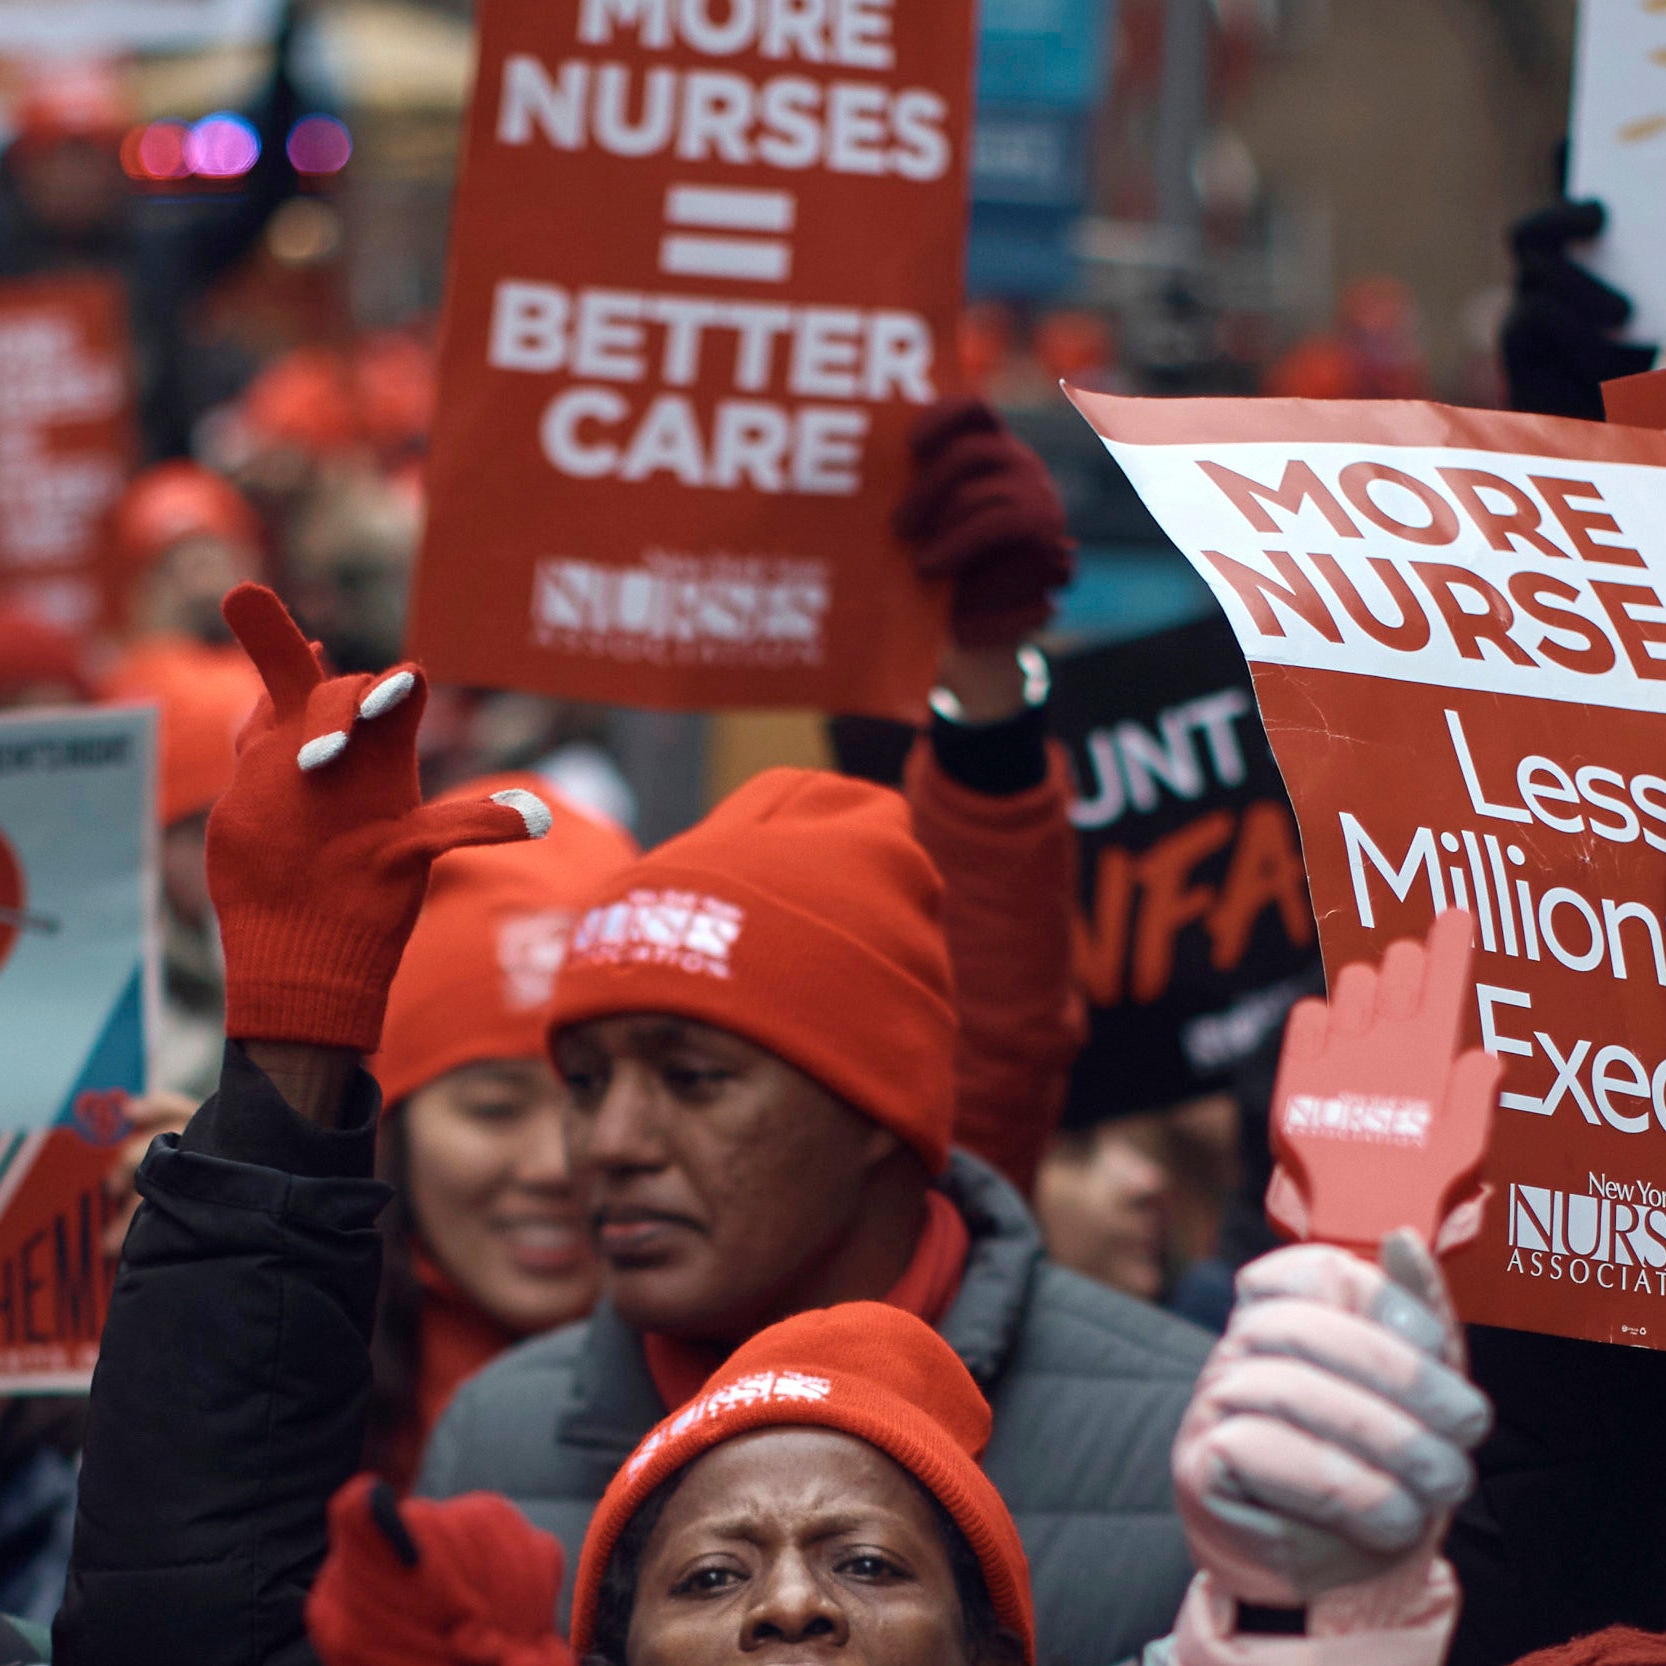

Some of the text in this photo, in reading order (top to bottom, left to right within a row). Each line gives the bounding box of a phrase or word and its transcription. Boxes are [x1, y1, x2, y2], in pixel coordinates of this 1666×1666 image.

[577, 0, 899, 70] MORE
[495, 54, 952, 181] NURSES
[487, 278, 936, 405] BETTER
[539, 388, 870, 498] CARE
[1193, 457, 1651, 571] MORE
[1589, 1171, 1634, 1201] New
